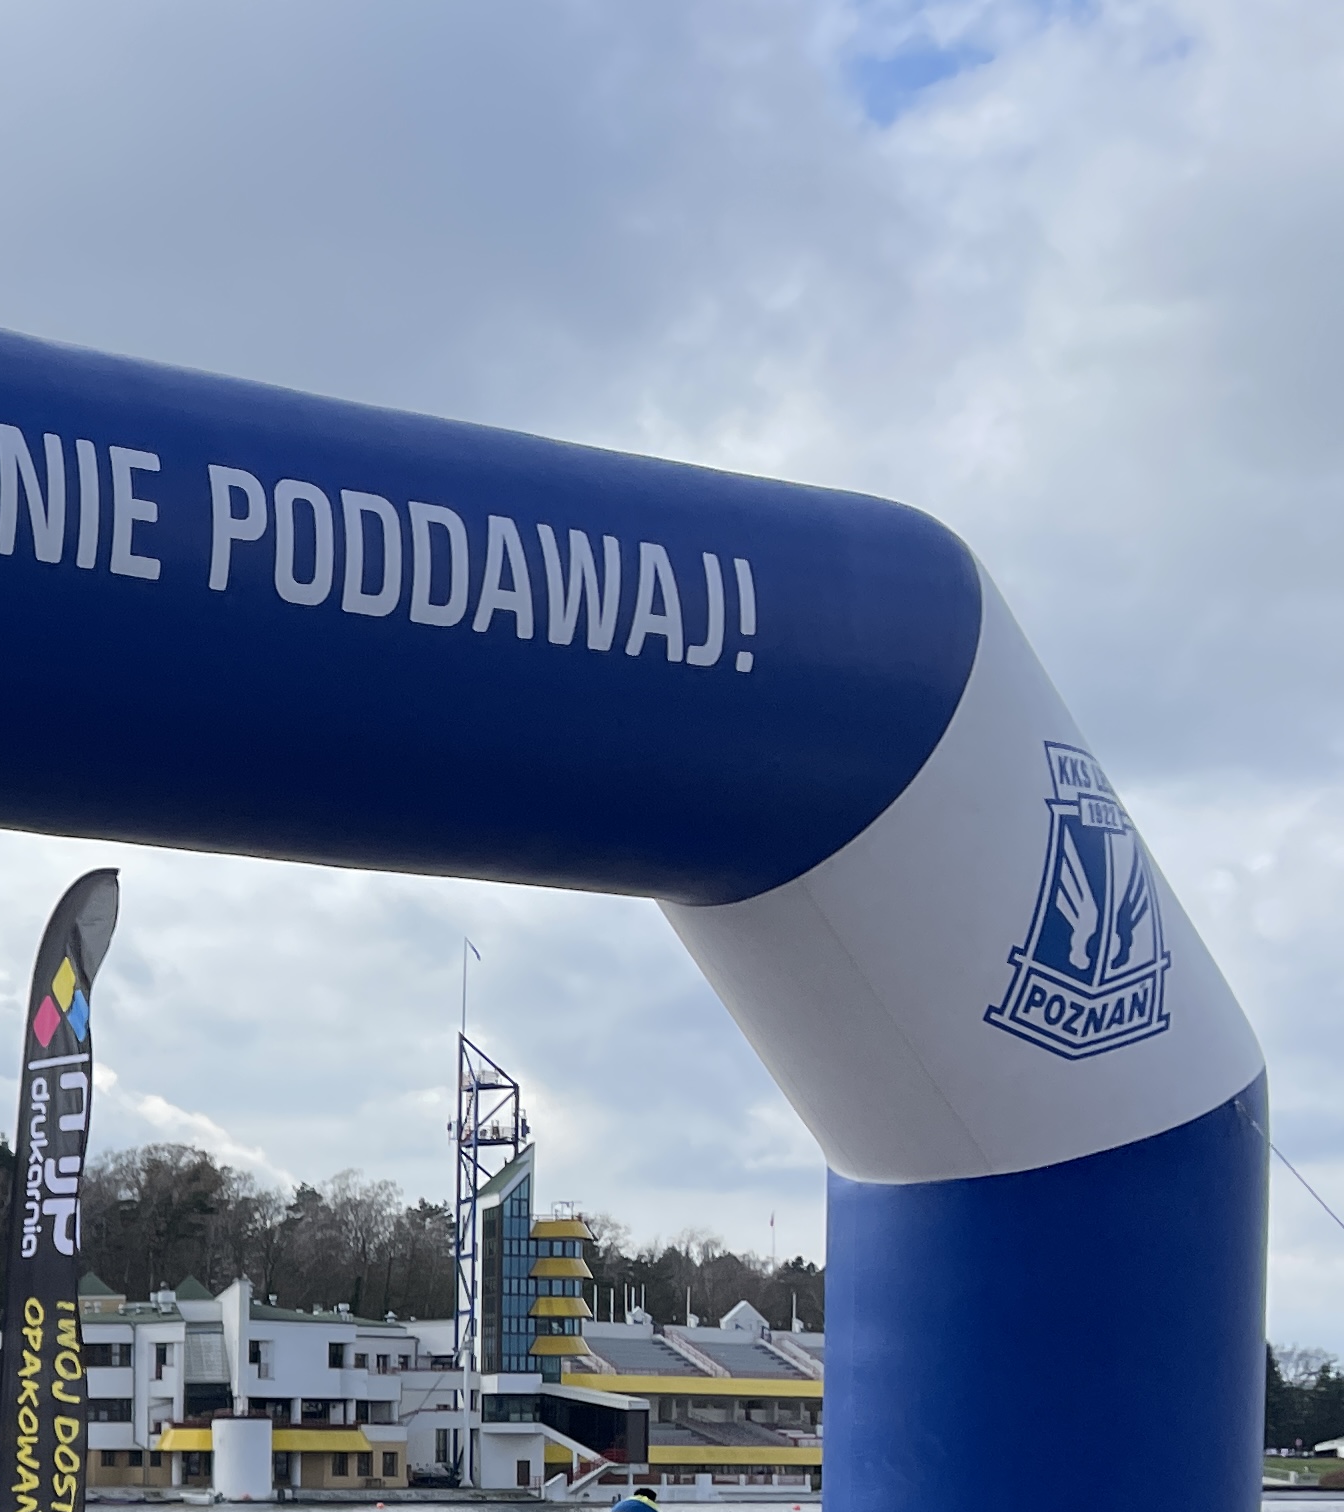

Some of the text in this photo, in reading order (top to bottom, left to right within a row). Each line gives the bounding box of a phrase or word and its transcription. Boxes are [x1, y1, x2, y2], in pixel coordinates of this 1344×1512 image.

[206, 462, 758, 675] PODDAWAJ!
[1058, 755, 1091, 789] KKS
[1022, 981, 1150, 1038] POZNAŃ
[21, 1076, 51, 1259] drukarnia
